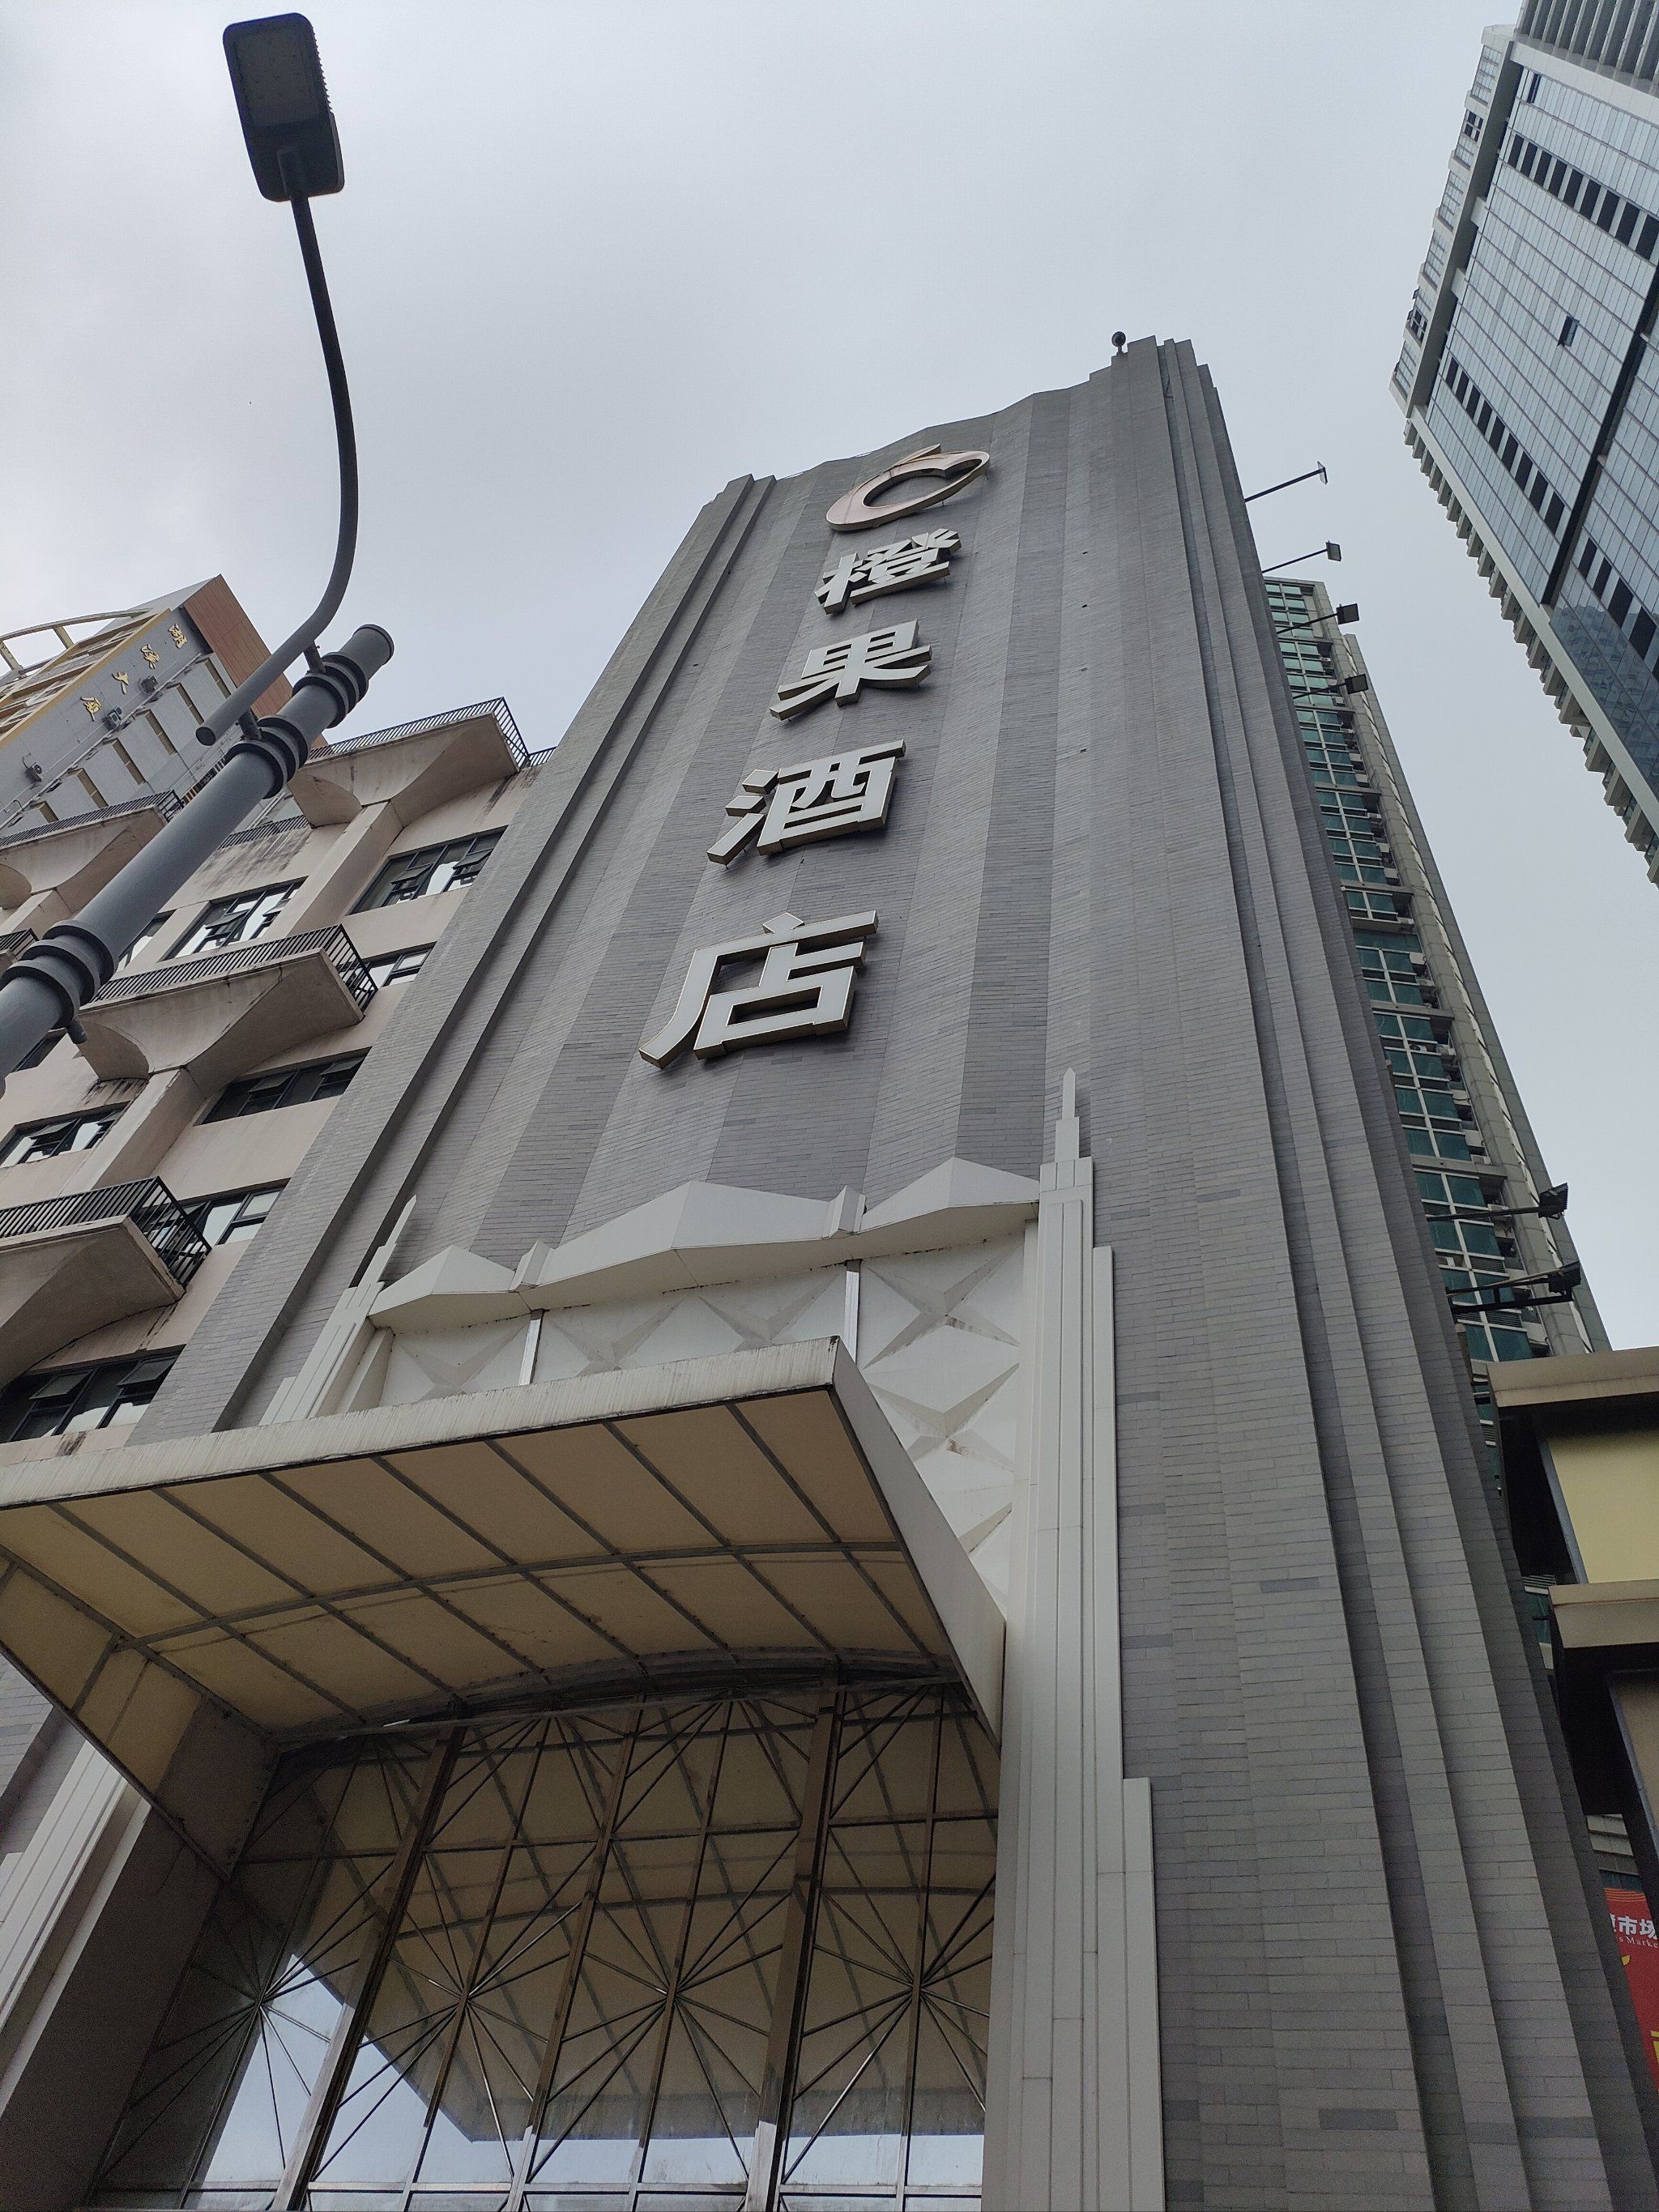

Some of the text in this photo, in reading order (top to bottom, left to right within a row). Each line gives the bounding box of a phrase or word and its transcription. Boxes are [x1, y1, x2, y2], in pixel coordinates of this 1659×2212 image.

[638, 528, 962, 1070] 橙果酒店
[1610, 1912, 1657, 1940] 市场
